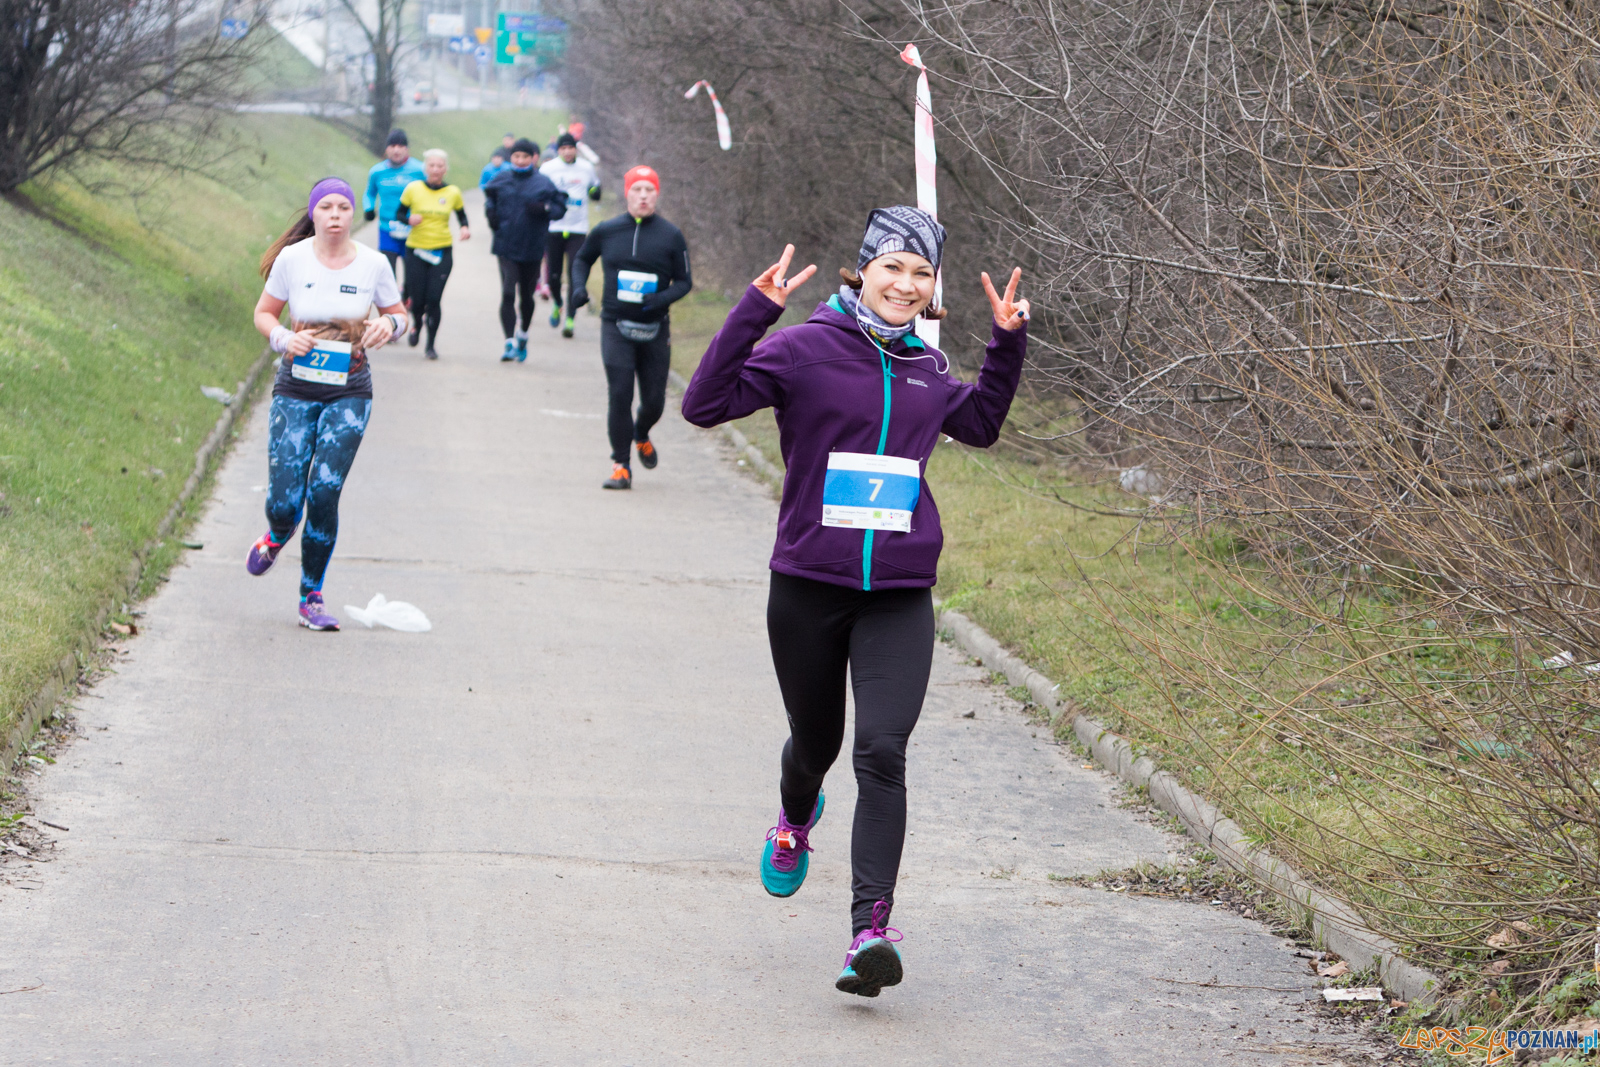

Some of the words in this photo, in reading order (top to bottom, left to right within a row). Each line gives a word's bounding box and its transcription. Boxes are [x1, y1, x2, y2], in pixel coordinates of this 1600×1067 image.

[630, 281, 644, 292] 47
[310, 352, 330, 367] 27
[868, 478, 884, 502] 7
